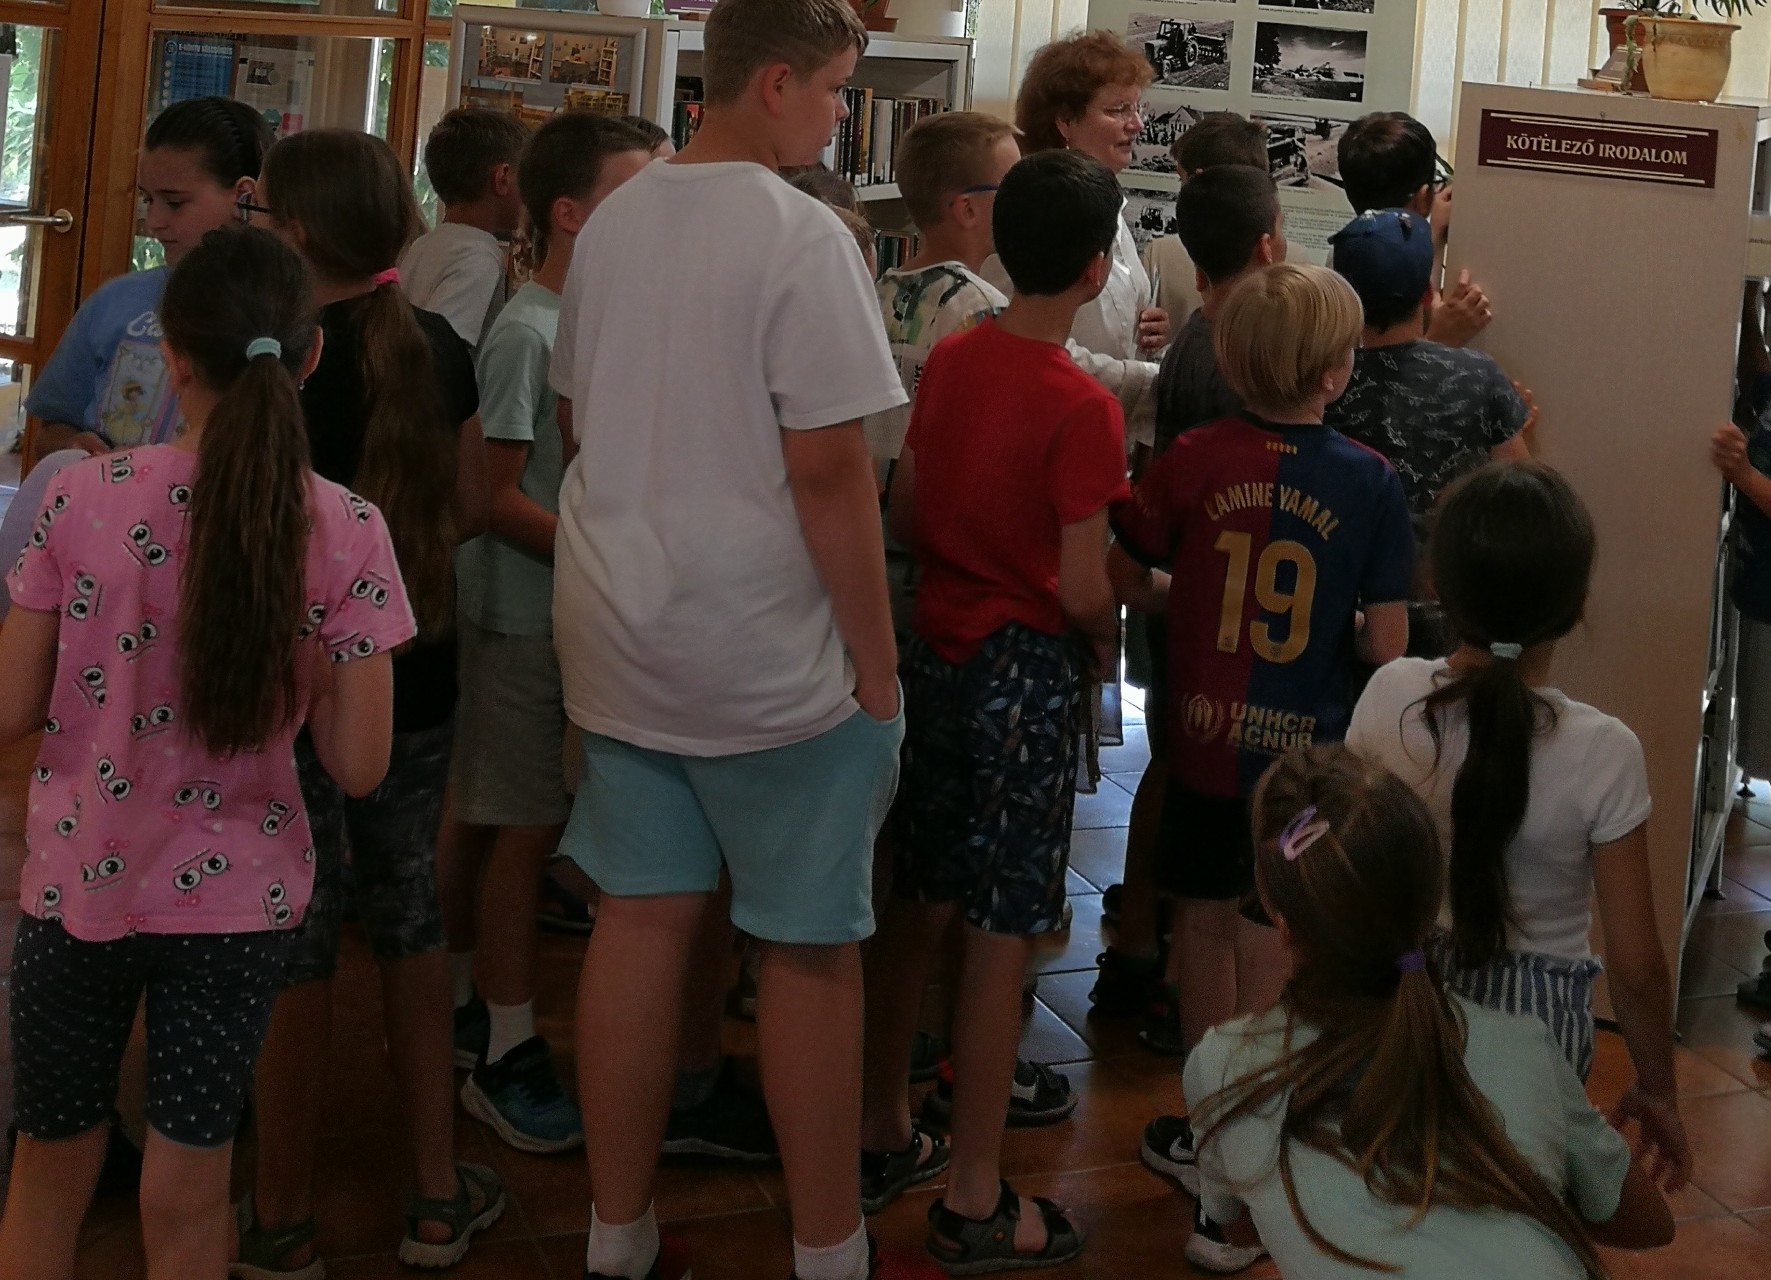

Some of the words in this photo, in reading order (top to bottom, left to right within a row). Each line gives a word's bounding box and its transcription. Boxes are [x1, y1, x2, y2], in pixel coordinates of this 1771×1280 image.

[1599, 143, 1688, 165] IRODALOM
[1203, 482, 1274, 521] LAMINE
[1279, 483, 1340, 542] YAMAL
[1213, 530, 1317, 664] 19
[1230, 702, 1317, 733] UNHCR
